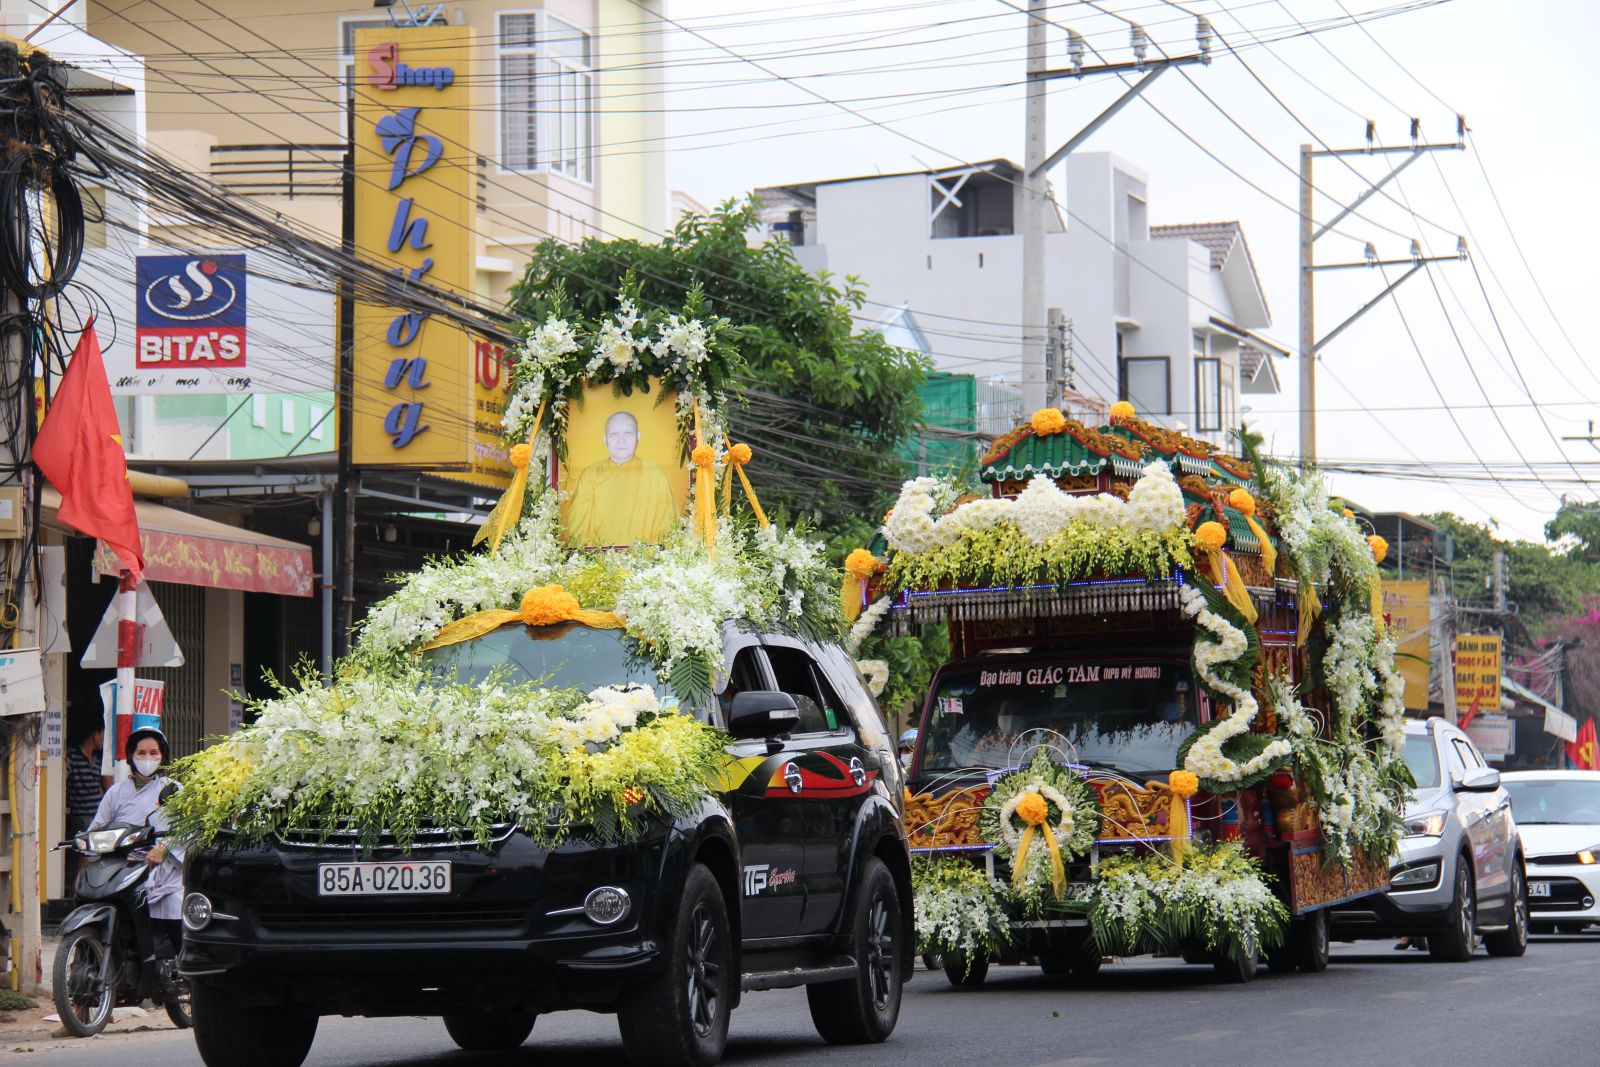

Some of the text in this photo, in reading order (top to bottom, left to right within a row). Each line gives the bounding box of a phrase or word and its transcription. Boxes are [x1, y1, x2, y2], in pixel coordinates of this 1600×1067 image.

[367, 42, 453, 91] Shop
[139, 331, 241, 363] BITA'S
[980, 670, 998, 688] Đạo
[1026, 666, 1063, 685] GIÁC
[1067, 665, 1100, 683] TÂM
[323, 865, 446, 892] 85A-020.36
